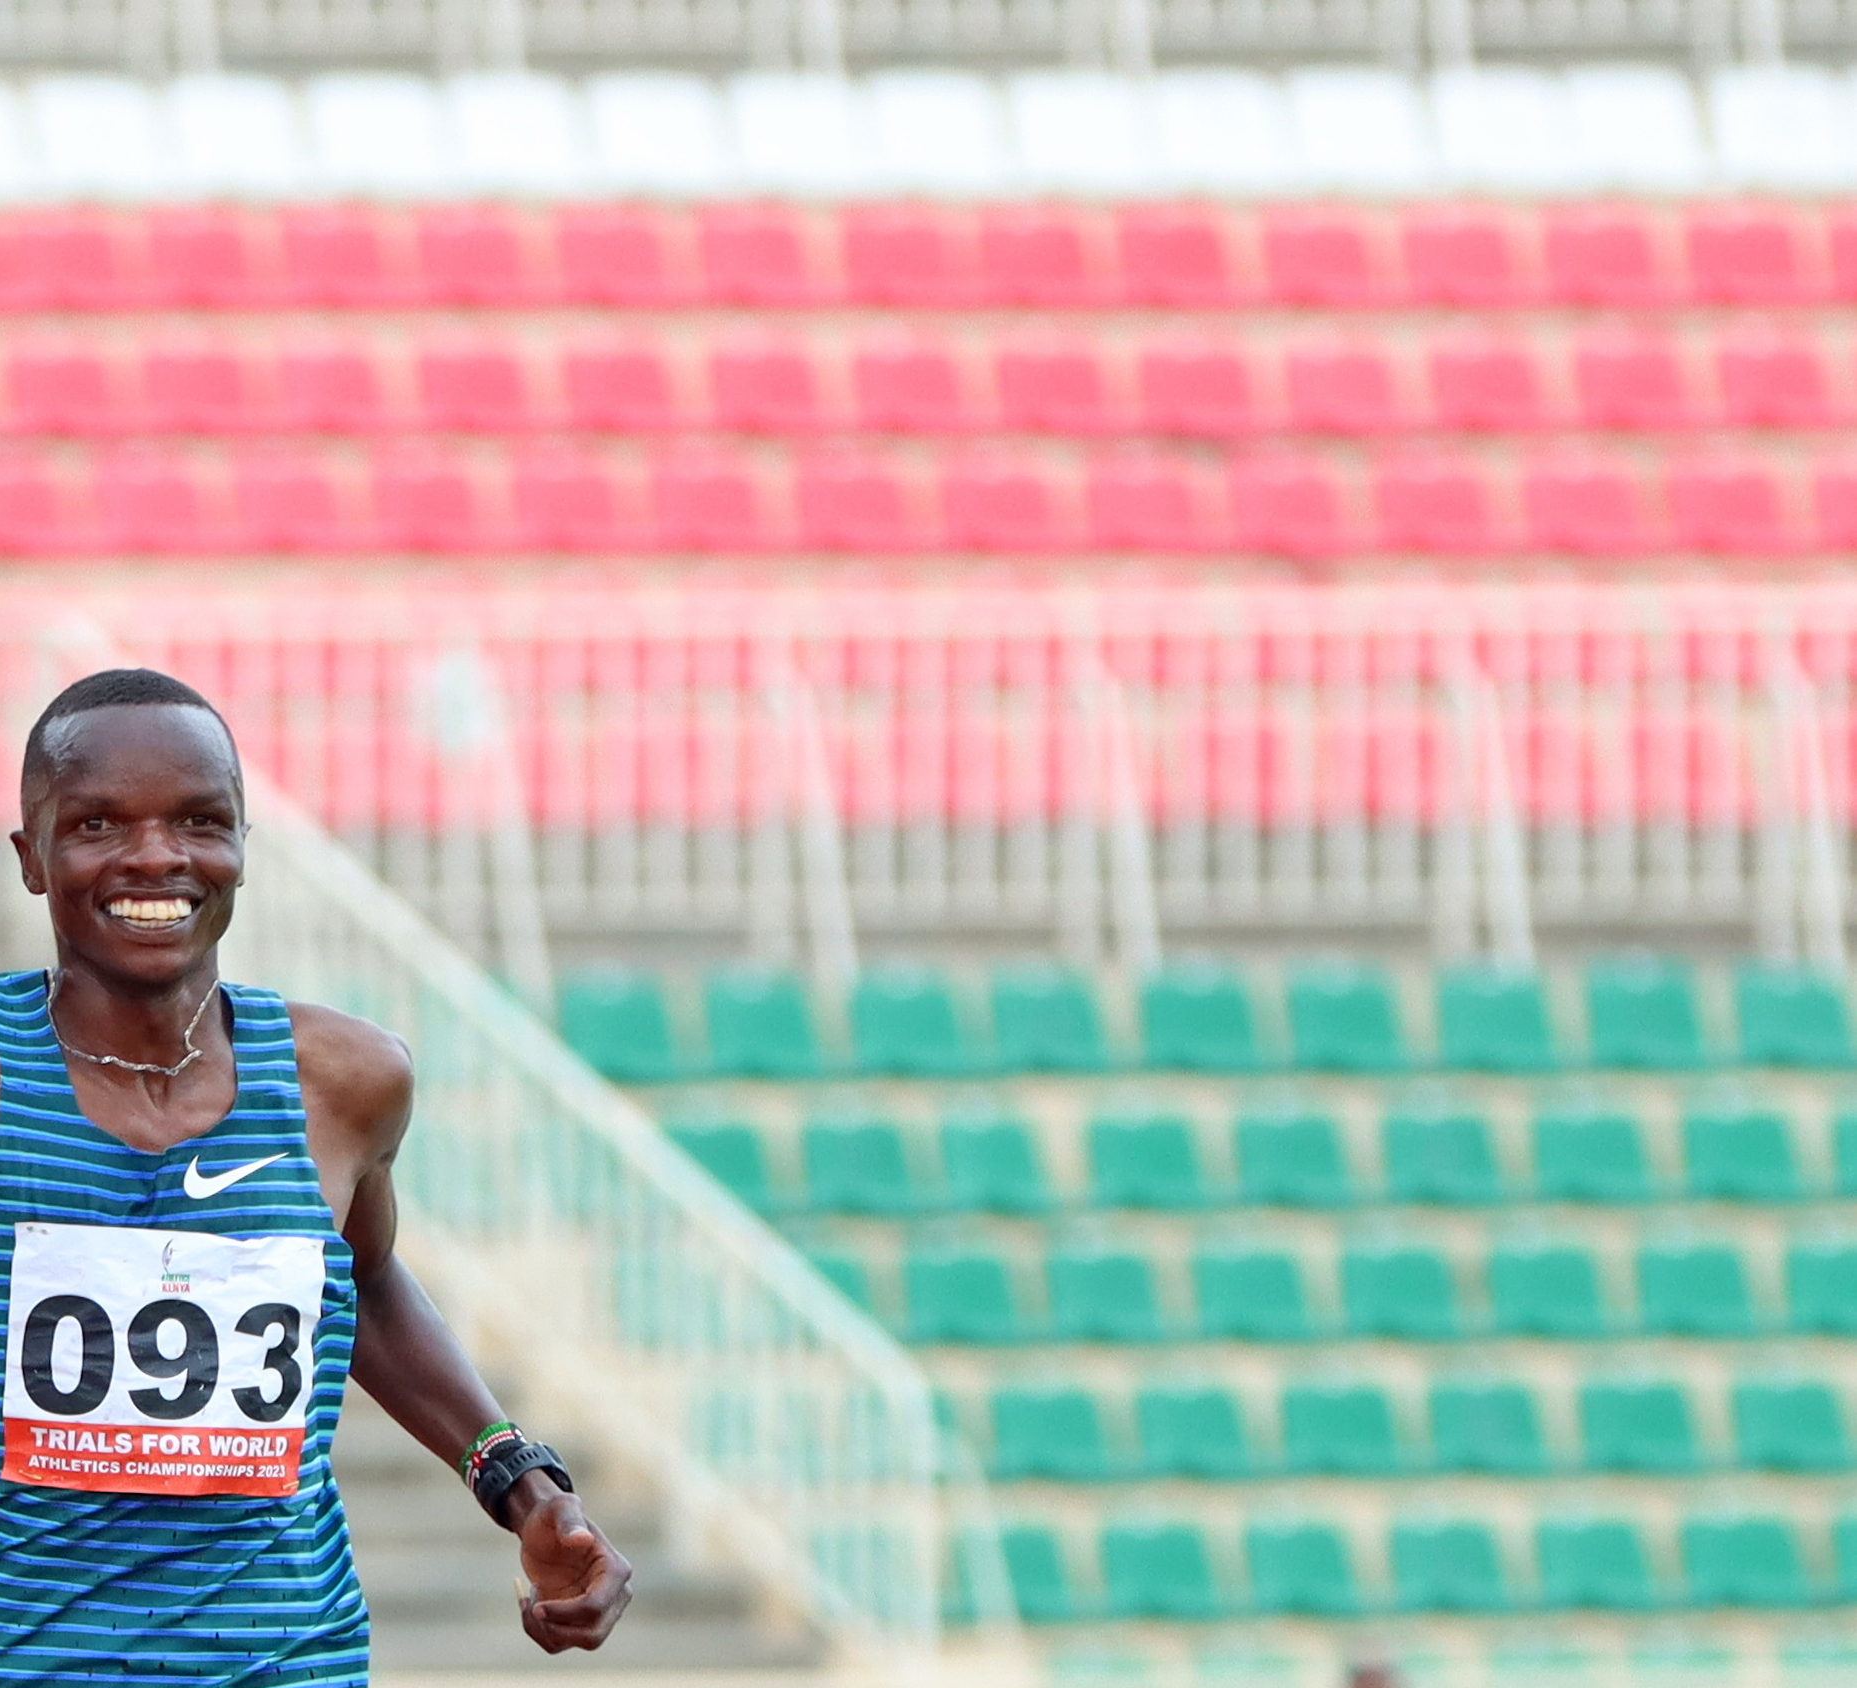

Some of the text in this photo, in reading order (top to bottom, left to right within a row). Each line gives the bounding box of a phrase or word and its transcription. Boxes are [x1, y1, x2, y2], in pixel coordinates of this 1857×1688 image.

[21, 1294, 303, 1423] 093
[29, 1426, 289, 1458] TRIALS FOR WORLD
[28, 1454, 286, 1479] ATHLETICS CHAMPIONSHIPS 2023
